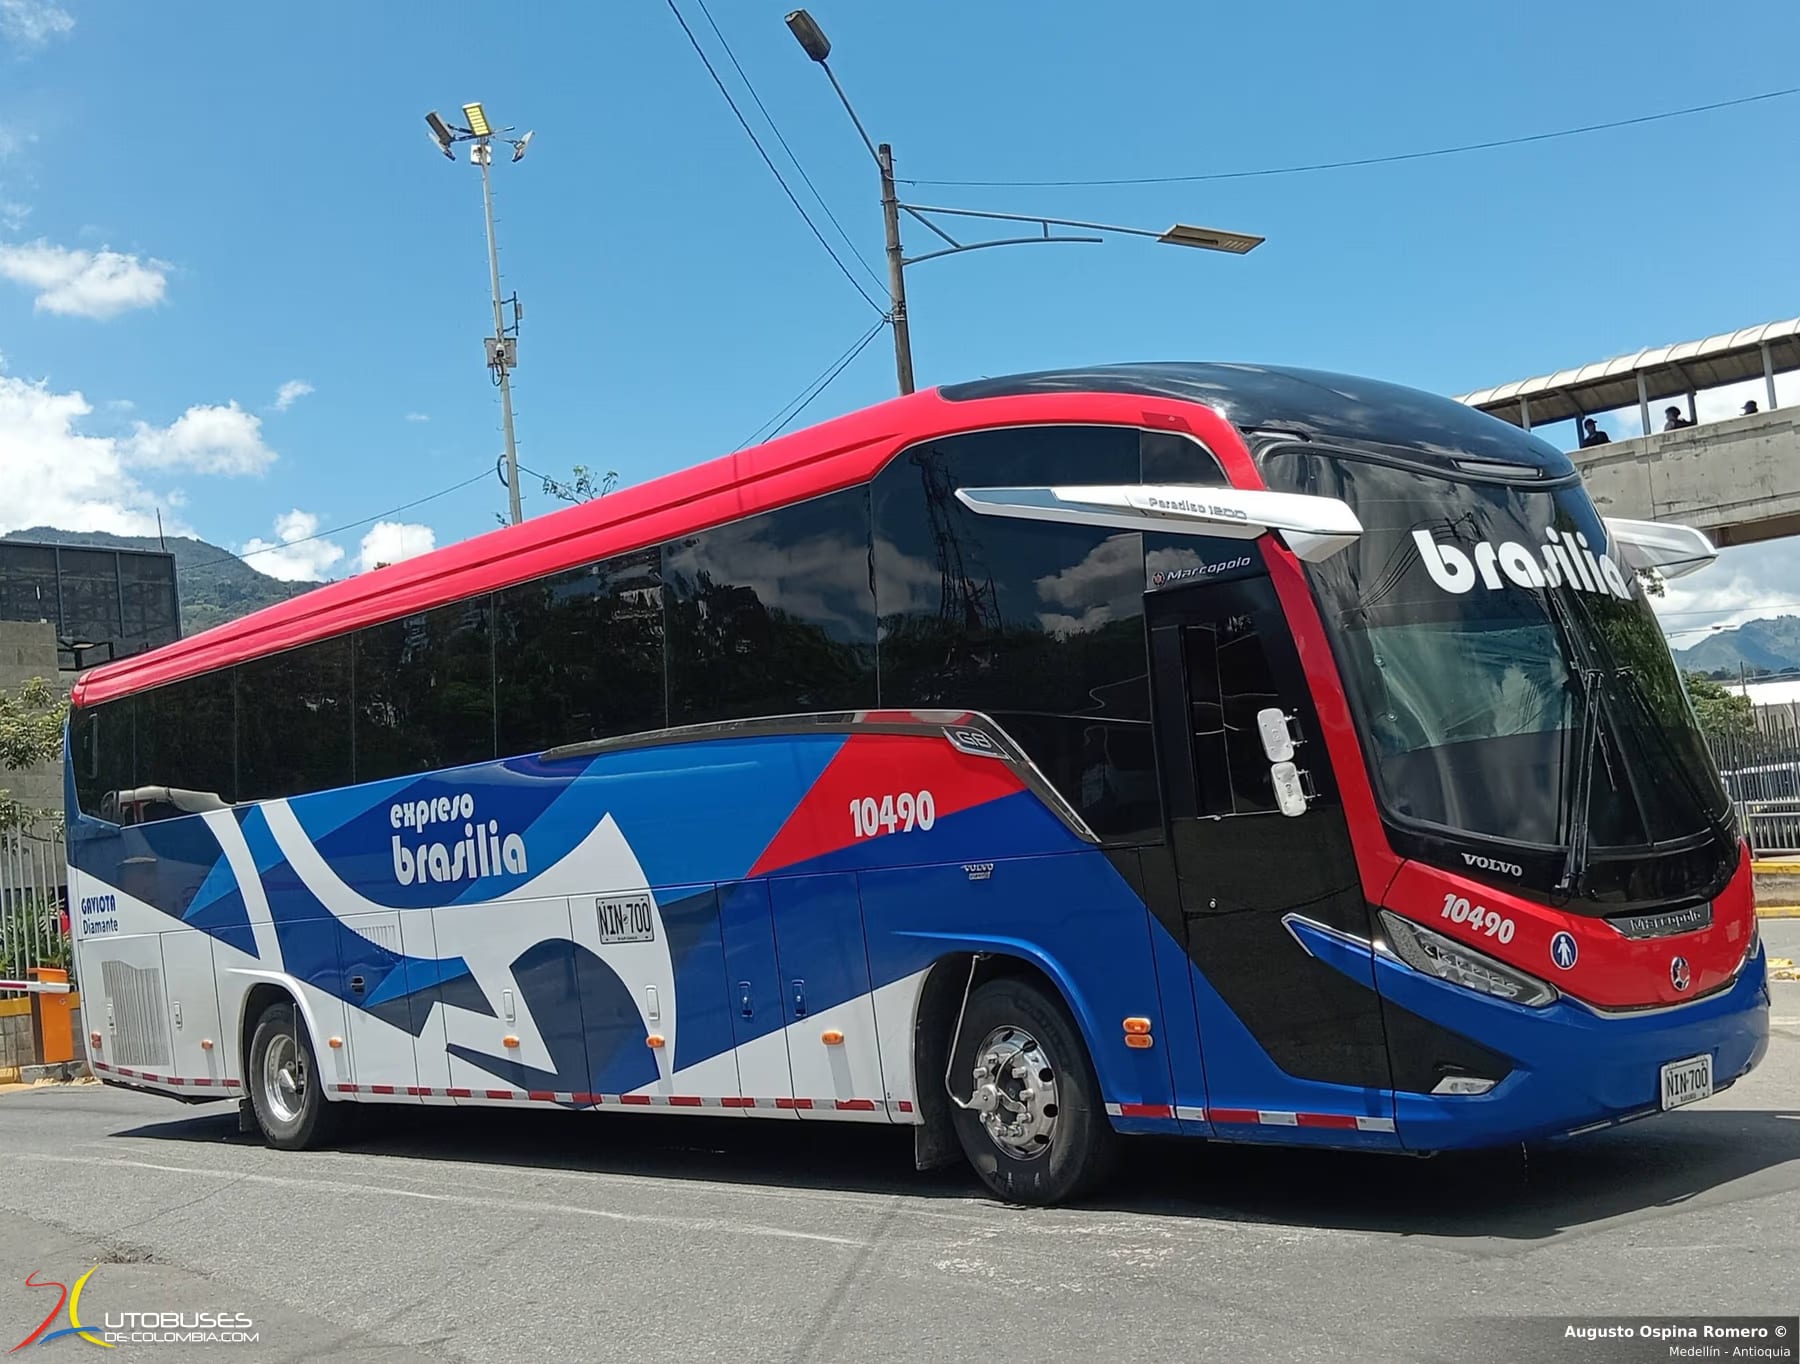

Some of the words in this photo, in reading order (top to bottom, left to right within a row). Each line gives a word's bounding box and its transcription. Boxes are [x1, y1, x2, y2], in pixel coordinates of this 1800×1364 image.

[1166, 556, 1251, 581] Marcopolo
[1411, 526, 1632, 600] brasilia
[390, 793, 474, 833] expreso
[850, 790, 936, 837] 10490
[392, 819, 527, 886] brasilia
[1461, 852, 1522, 878] VOLVO
[81, 894, 116, 915] GAVIOTA
[1441, 893, 1516, 945] 10490
[83, 918, 119, 934] Diamante
